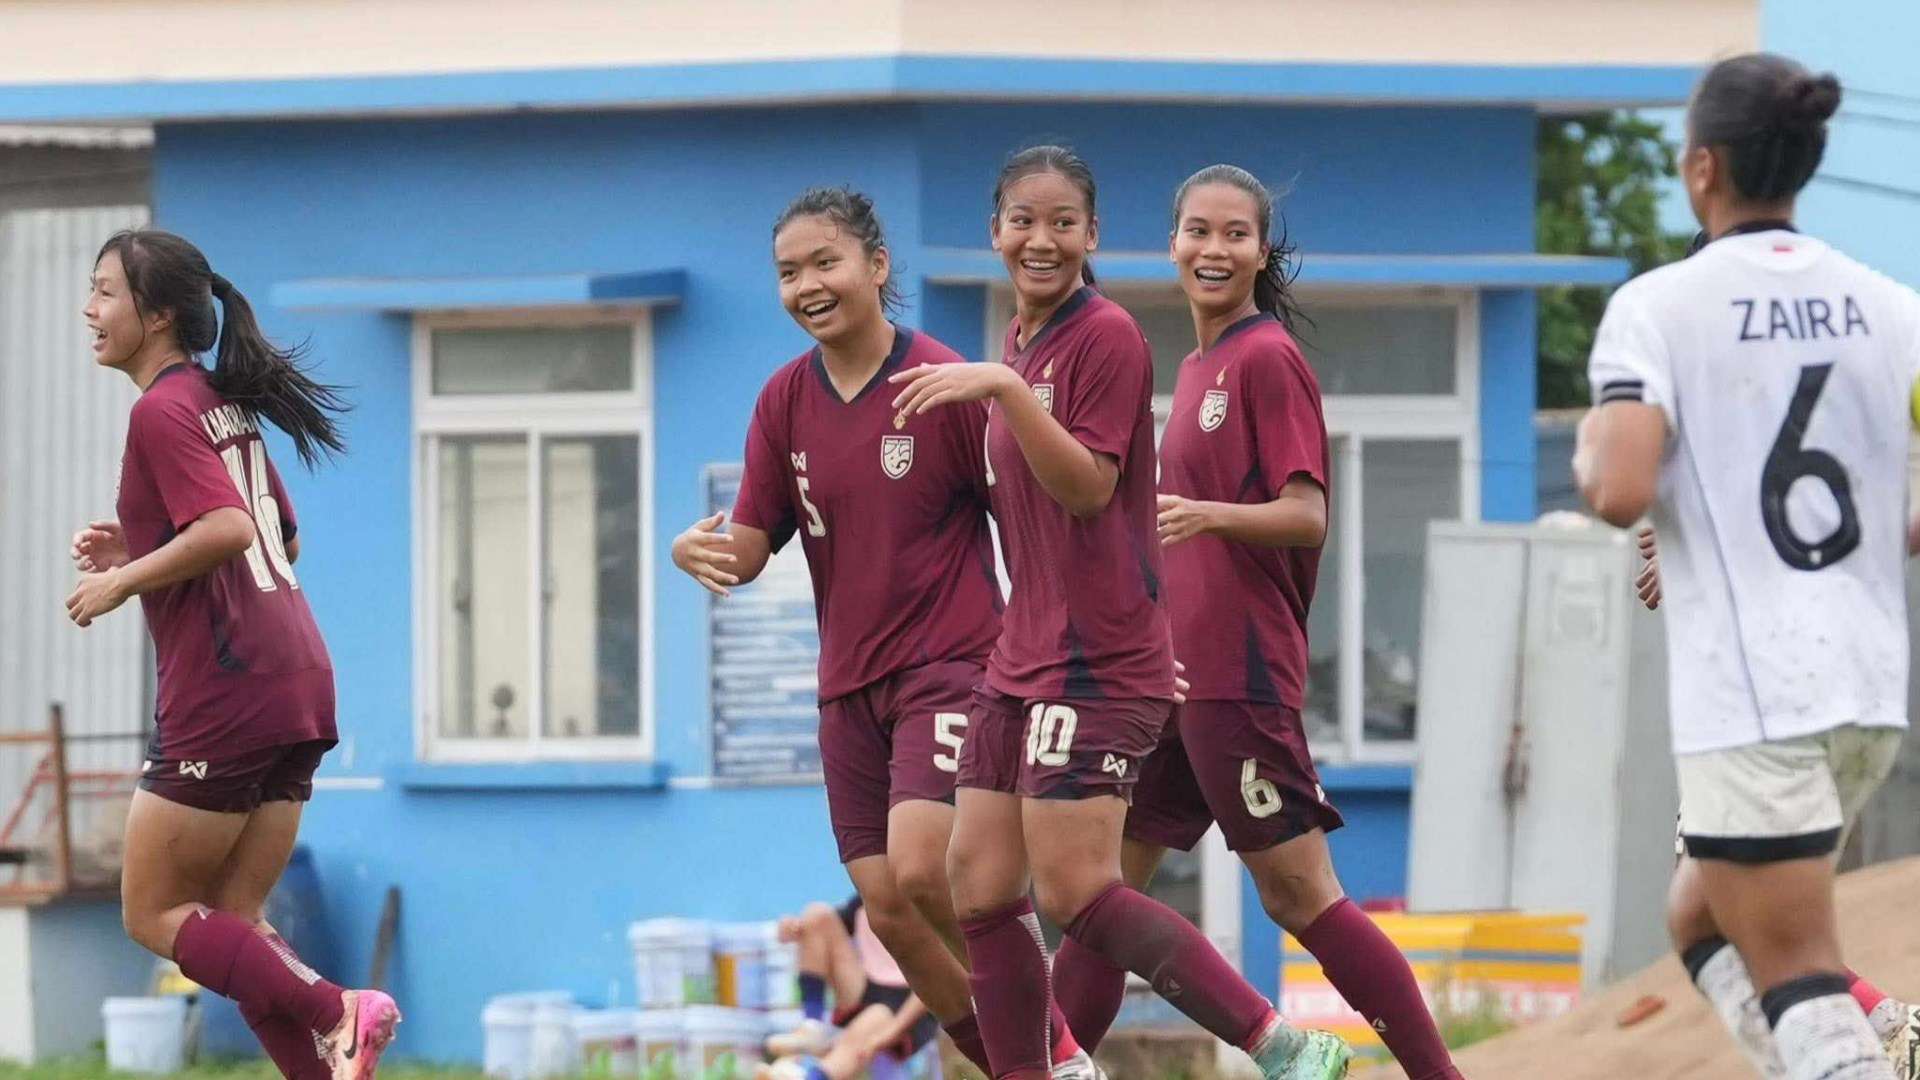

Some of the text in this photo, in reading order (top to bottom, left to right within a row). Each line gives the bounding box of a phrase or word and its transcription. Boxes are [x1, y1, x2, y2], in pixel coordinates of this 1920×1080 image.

[1731, 295, 1870, 341] ZAIRA
[1761, 361, 1861, 572] 6
[220, 440, 298, 591] 16
[797, 476, 826, 537] 5
[934, 712, 968, 772] 5
[1026, 703, 1078, 767] 10
[1241, 758, 1282, 818] 6
